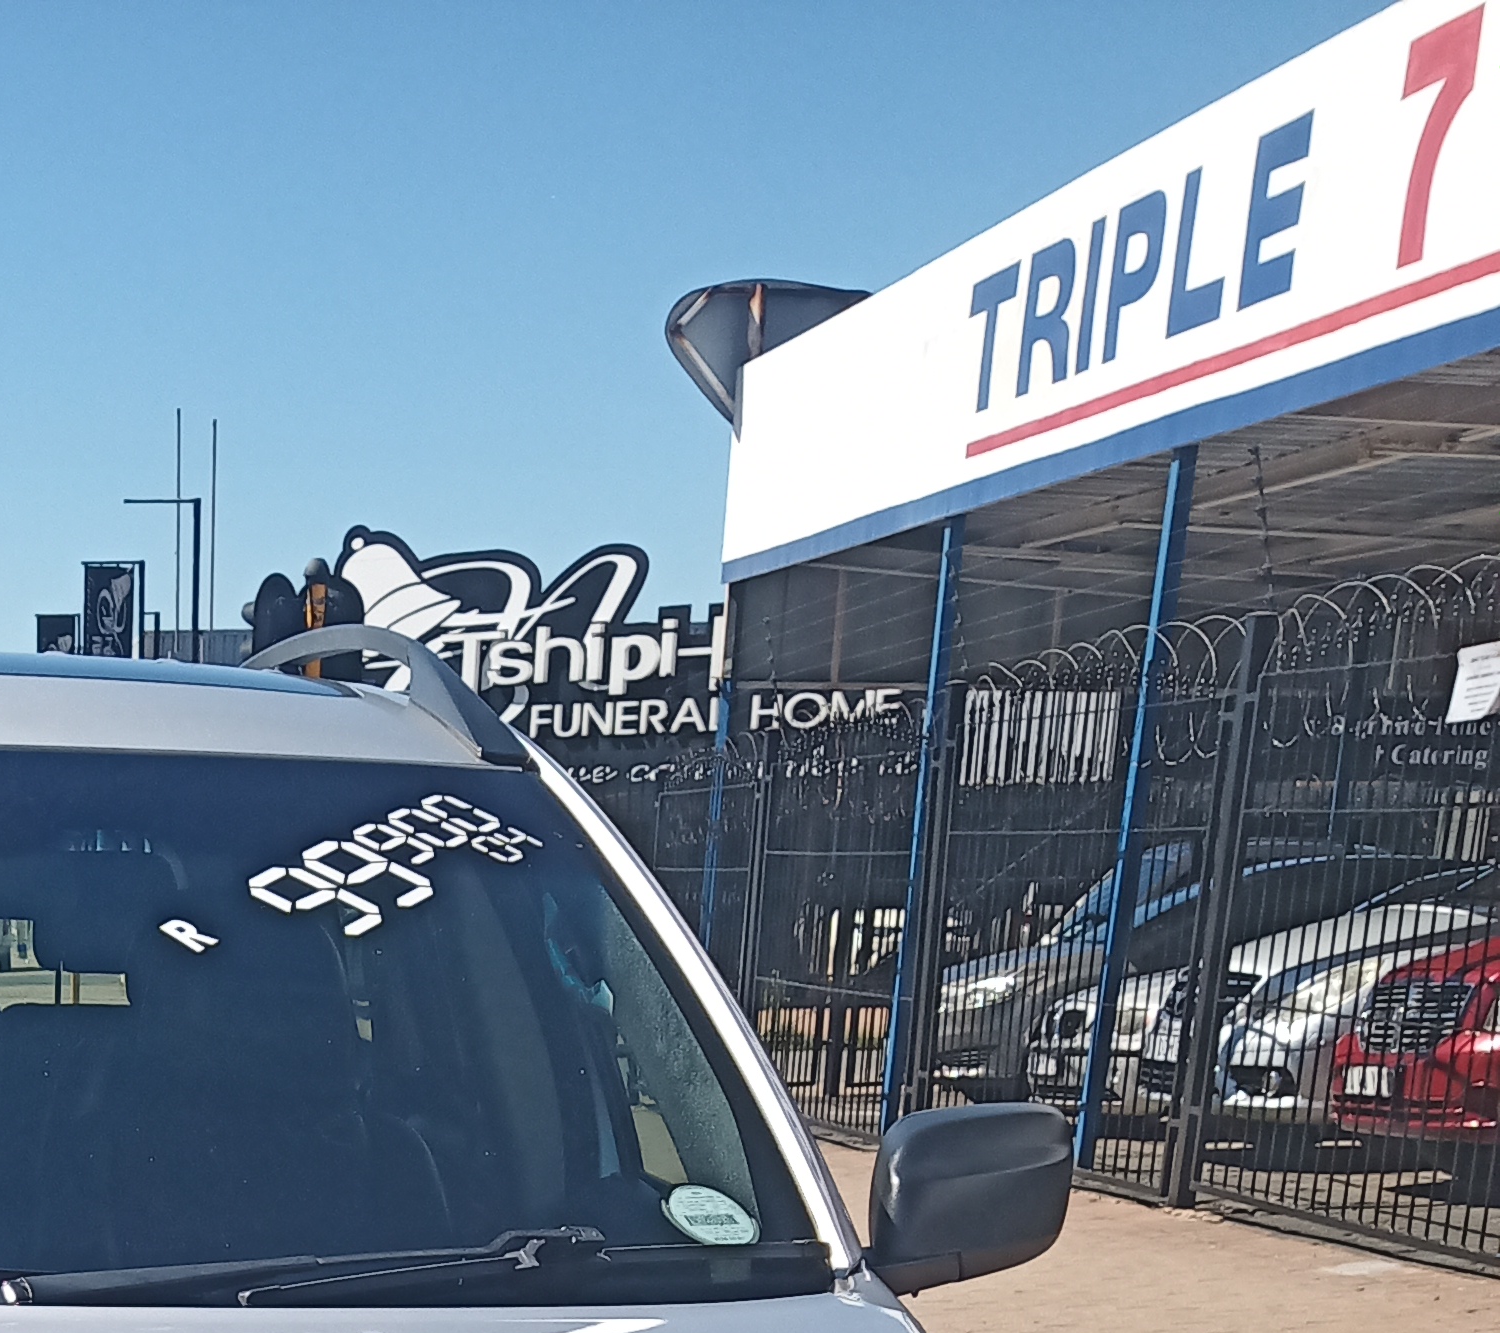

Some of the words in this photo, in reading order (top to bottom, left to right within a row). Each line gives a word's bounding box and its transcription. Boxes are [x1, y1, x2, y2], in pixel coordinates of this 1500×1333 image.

[970, 109, 1315, 413] TRIPLE
[1397, 4, 1486, 270] 7
[749, 687, 903, 731] HOME
[159, 918, 220, 954] R
[248, 794, 501, 937] 99900
